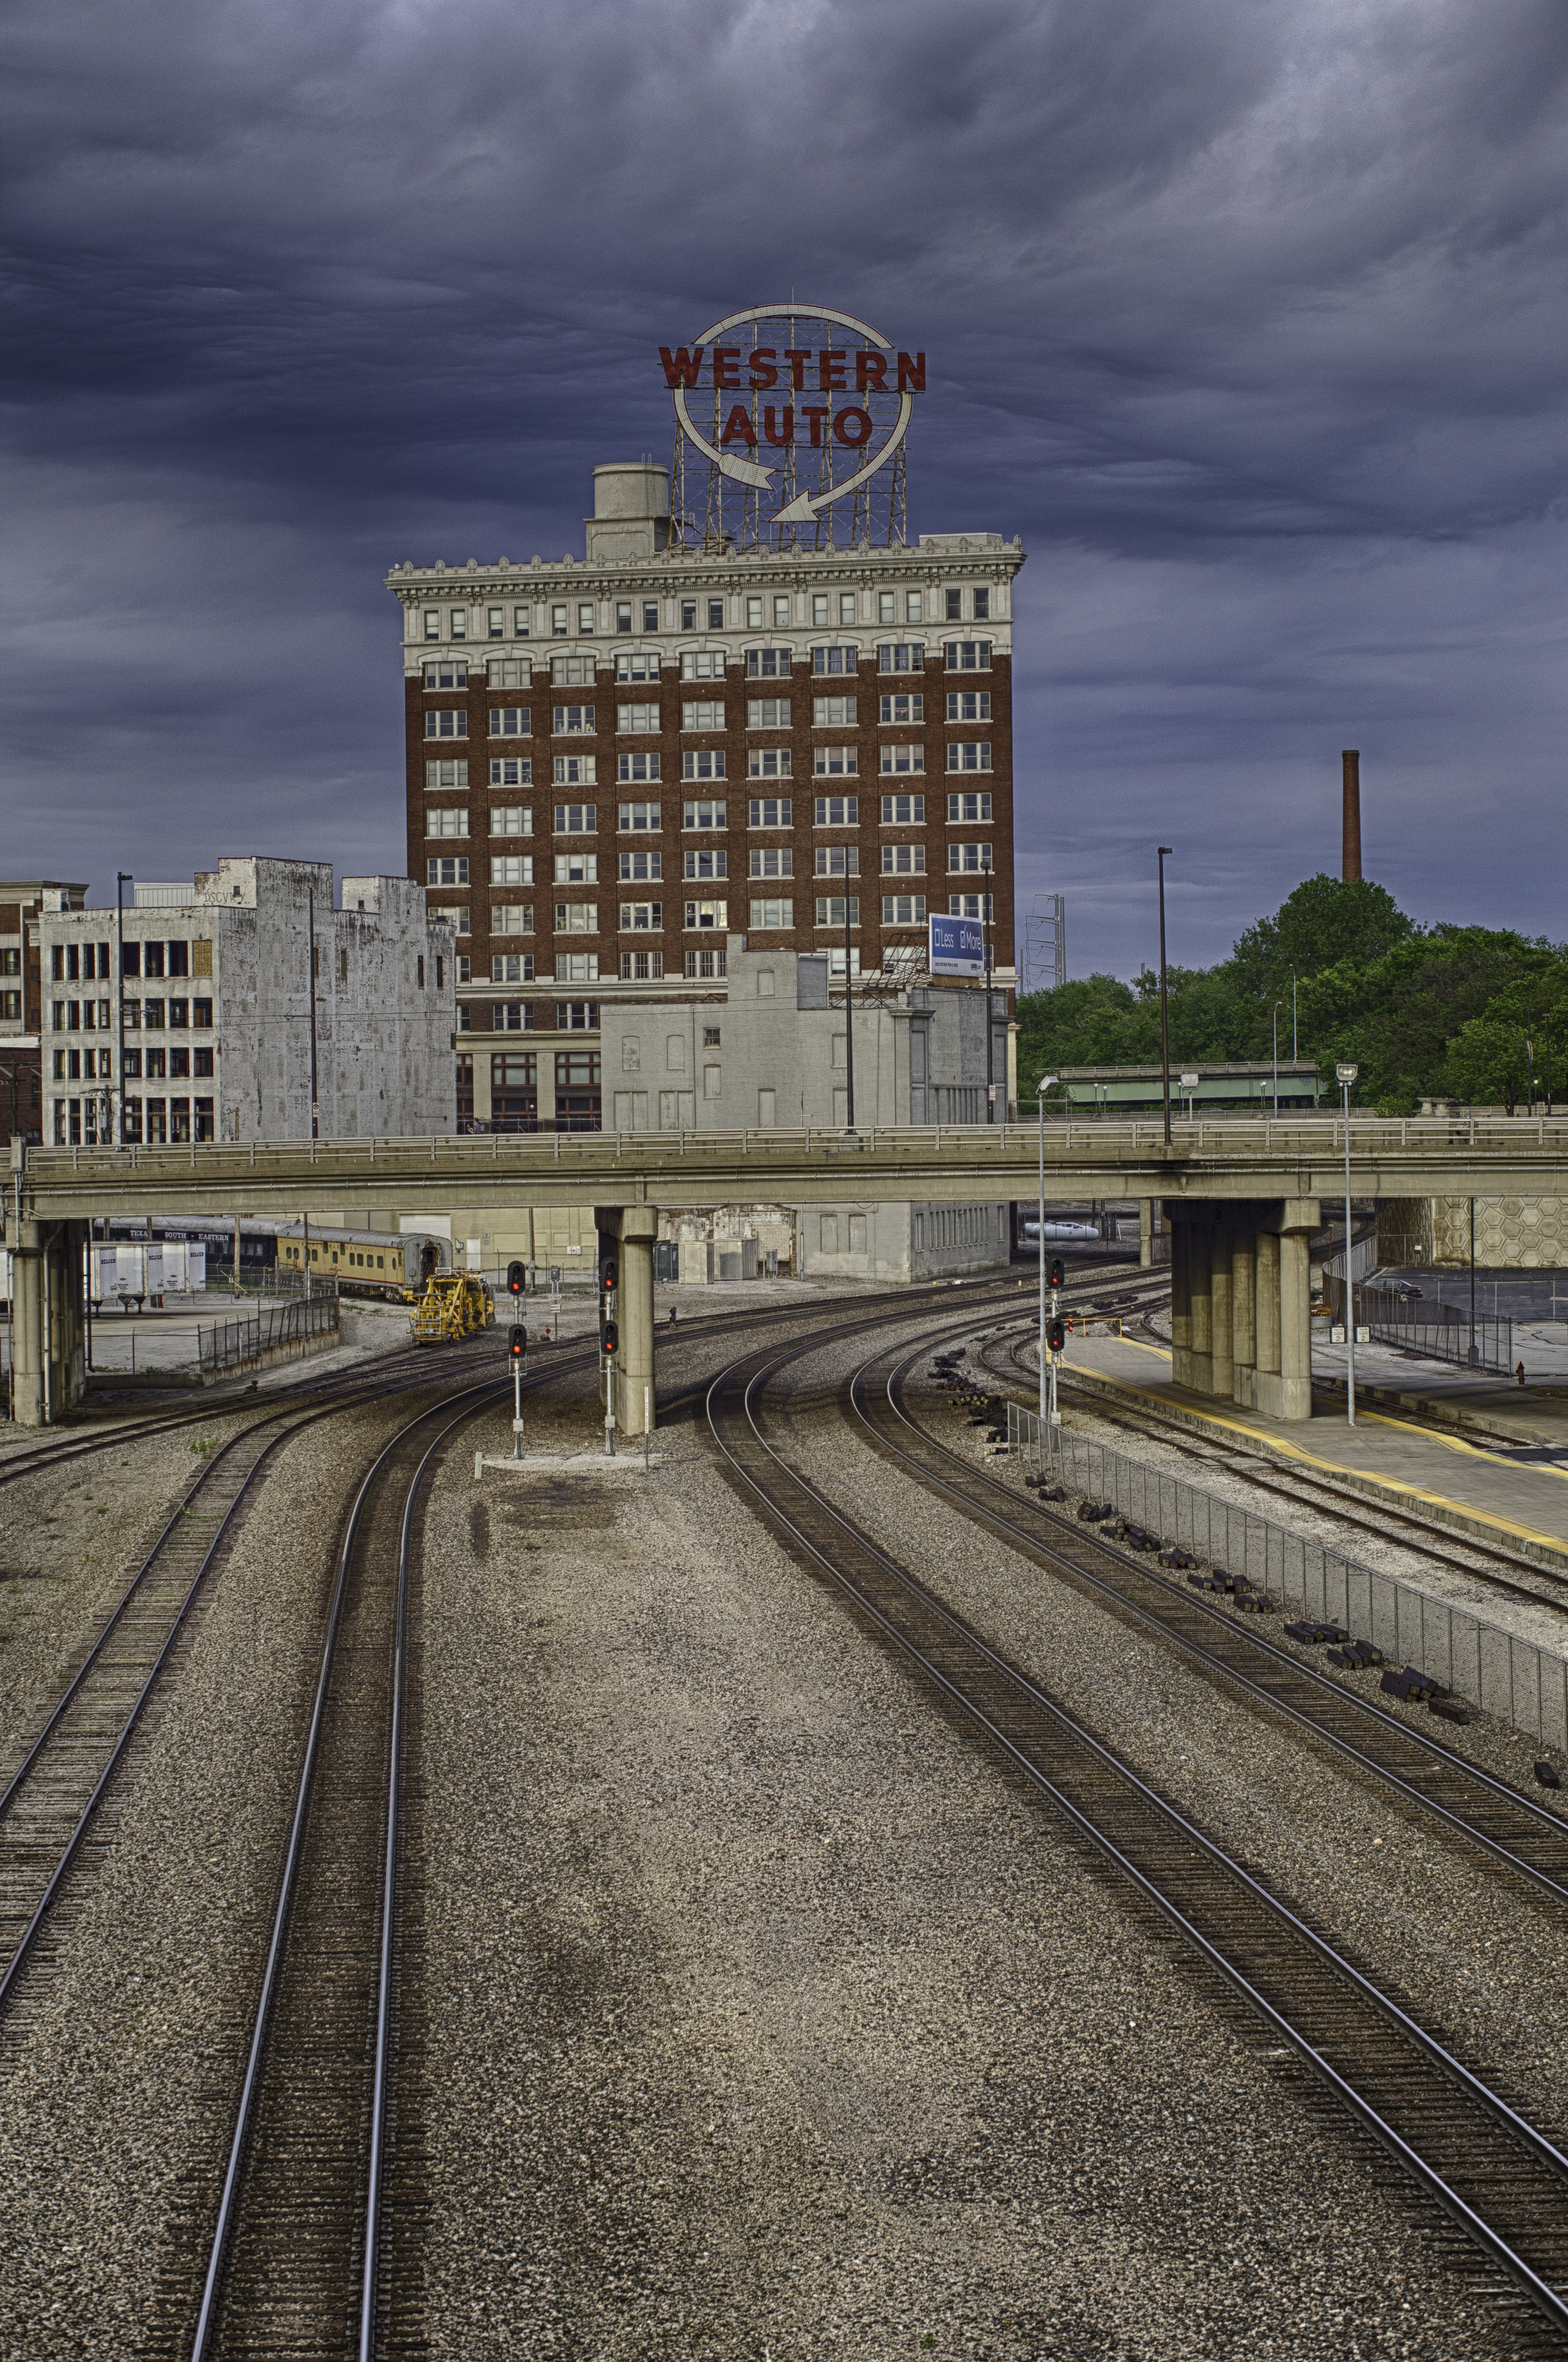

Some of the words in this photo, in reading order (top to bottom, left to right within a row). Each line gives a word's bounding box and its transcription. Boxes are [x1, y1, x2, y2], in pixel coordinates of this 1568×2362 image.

[658, 347, 926, 391] WESTERN
[721, 405, 873, 447] AUTO
[941, 929, 954, 948] Less
[966, 931, 981, 950] More
